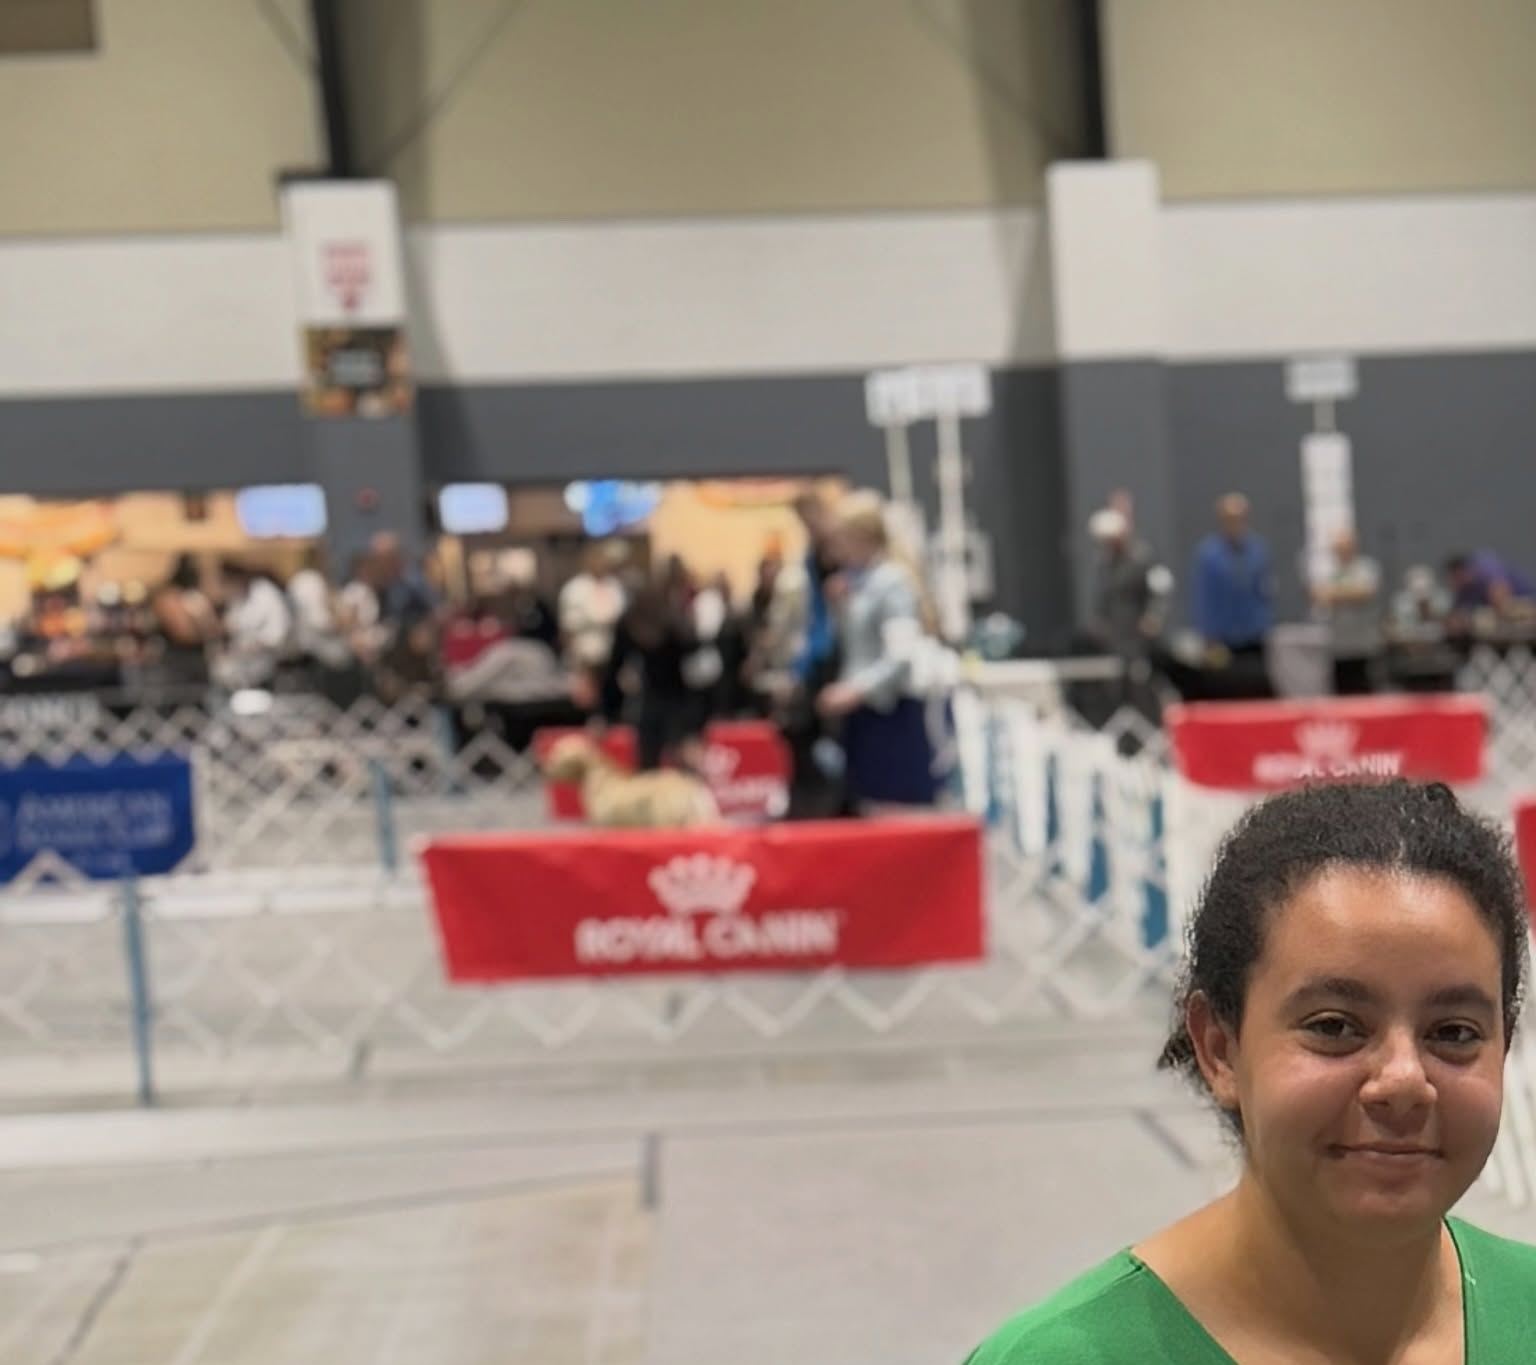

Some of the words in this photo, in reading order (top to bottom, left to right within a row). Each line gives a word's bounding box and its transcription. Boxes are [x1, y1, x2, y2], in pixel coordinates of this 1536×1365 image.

[1328, 750, 1401, 780] CANIN
[573, 914, 702, 966] ROYAL
[702, 907, 842, 961] CANIN
